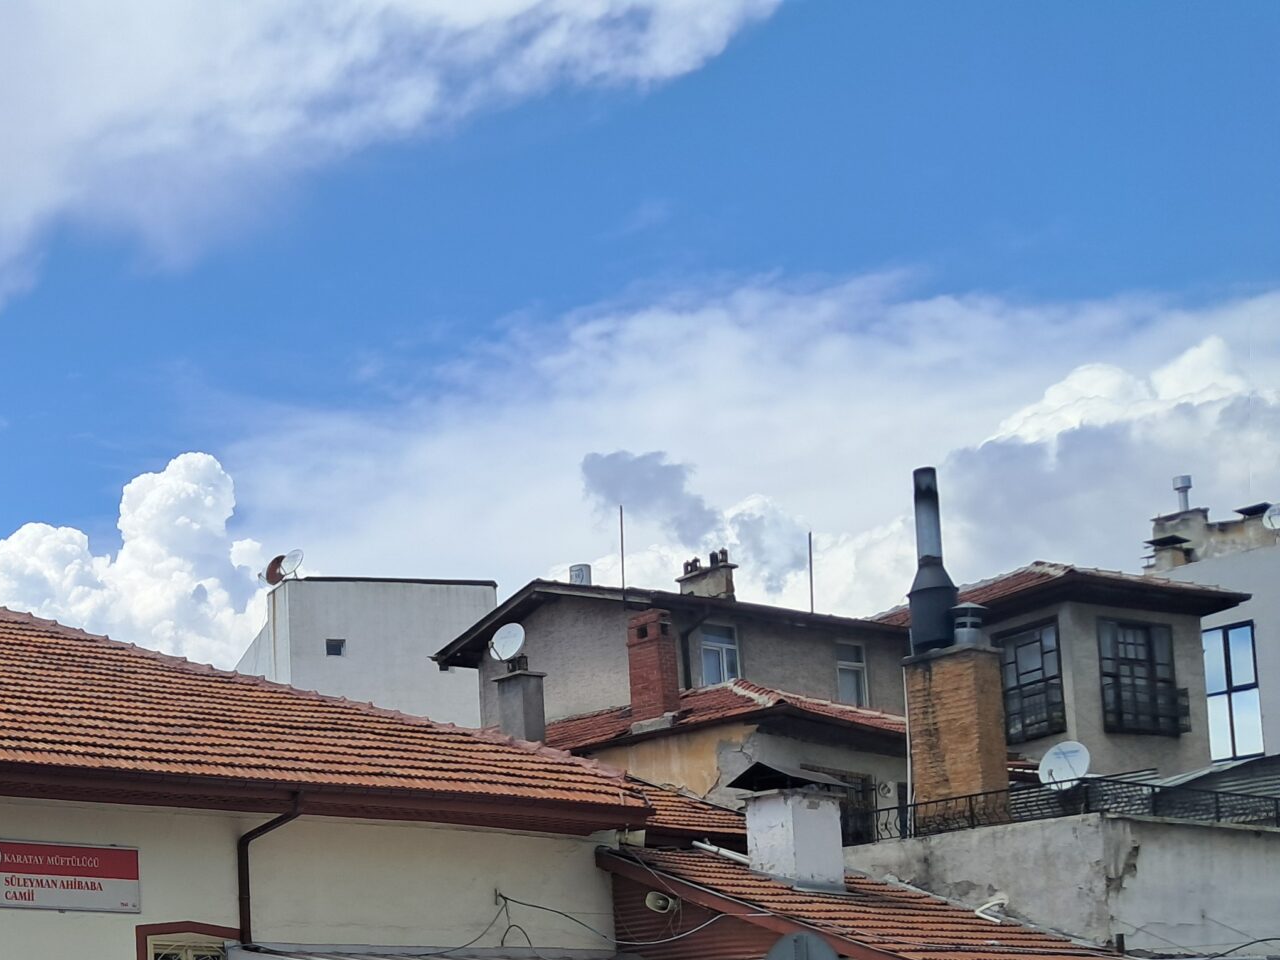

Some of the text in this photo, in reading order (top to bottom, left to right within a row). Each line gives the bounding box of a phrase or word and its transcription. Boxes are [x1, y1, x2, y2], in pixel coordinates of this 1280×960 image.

[4, 853, 100, 868] KARATAY MÜFTÜLÜĞÜ
[4, 875, 103, 892] SÜLEYMAN AHİBABA
[5, 889, 34, 901] CAMİİ
